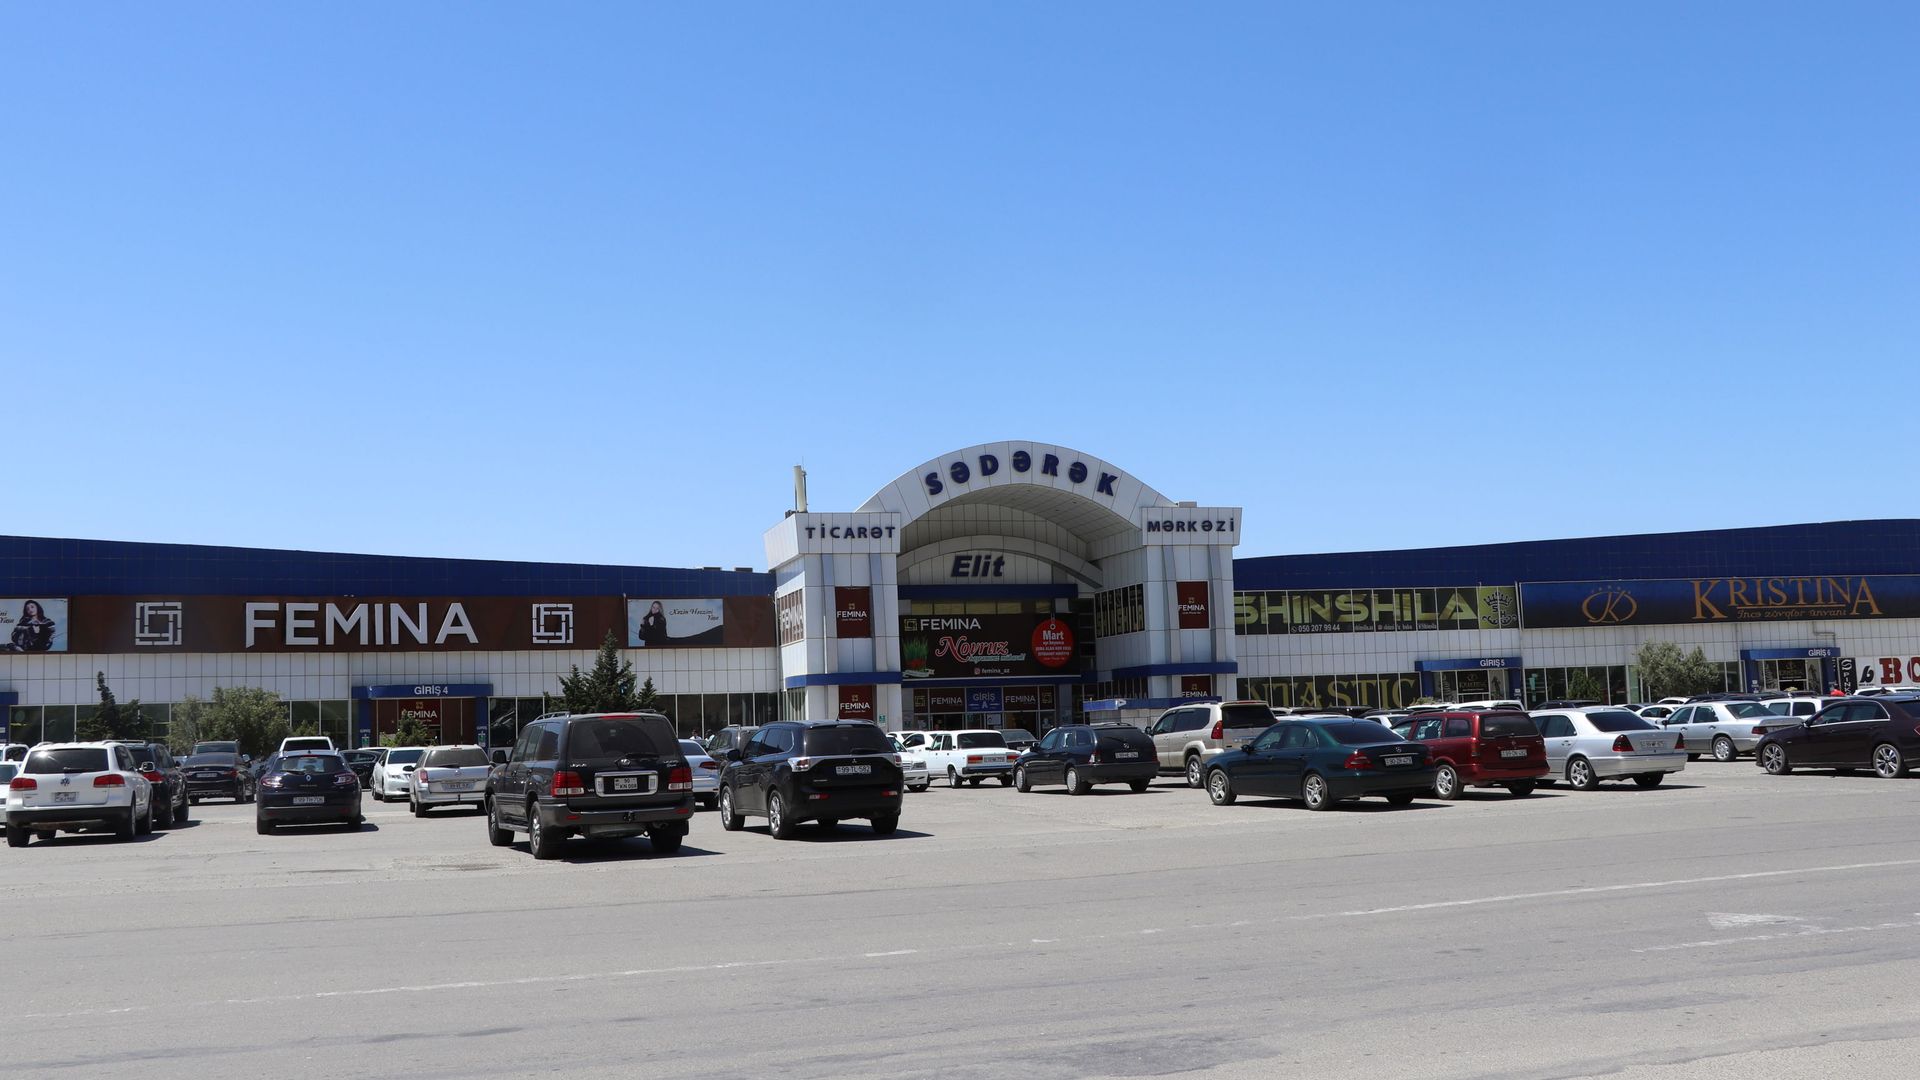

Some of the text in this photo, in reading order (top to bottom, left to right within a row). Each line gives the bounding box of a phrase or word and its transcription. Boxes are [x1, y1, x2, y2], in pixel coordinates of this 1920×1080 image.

[925, 450, 1118, 497] SƏDƏRƏK
[805, 523, 896, 539] TİCARƏT
[1146, 517, 1235, 532] MƏRKƏZİ
[950, 554, 1005, 578] Elit
[1690, 576, 1884, 620] KRISTINA
[836, 610, 868, 618] FEMINA
[1178, 604, 1206, 612] FEMINA
[1235, 592, 1478, 625] SHINSHILA
[245, 602, 480, 648] FEMINA
[919, 617, 982, 631] FEMINA
[1298, 625, 1310, 633] 050
[1324, 624, 1332, 632] 99
[1332, 624, 1341, 632] 44
[1042, 630, 1064, 640] Mart
[934, 635, 1009, 663] Novruz
[413, 685, 449, 697] GİRİŞ 4
[840, 702, 871, 710] FEMINA
[931, 697, 963, 705] FEMINA
[1005, 695, 1036, 703] FEMINA
